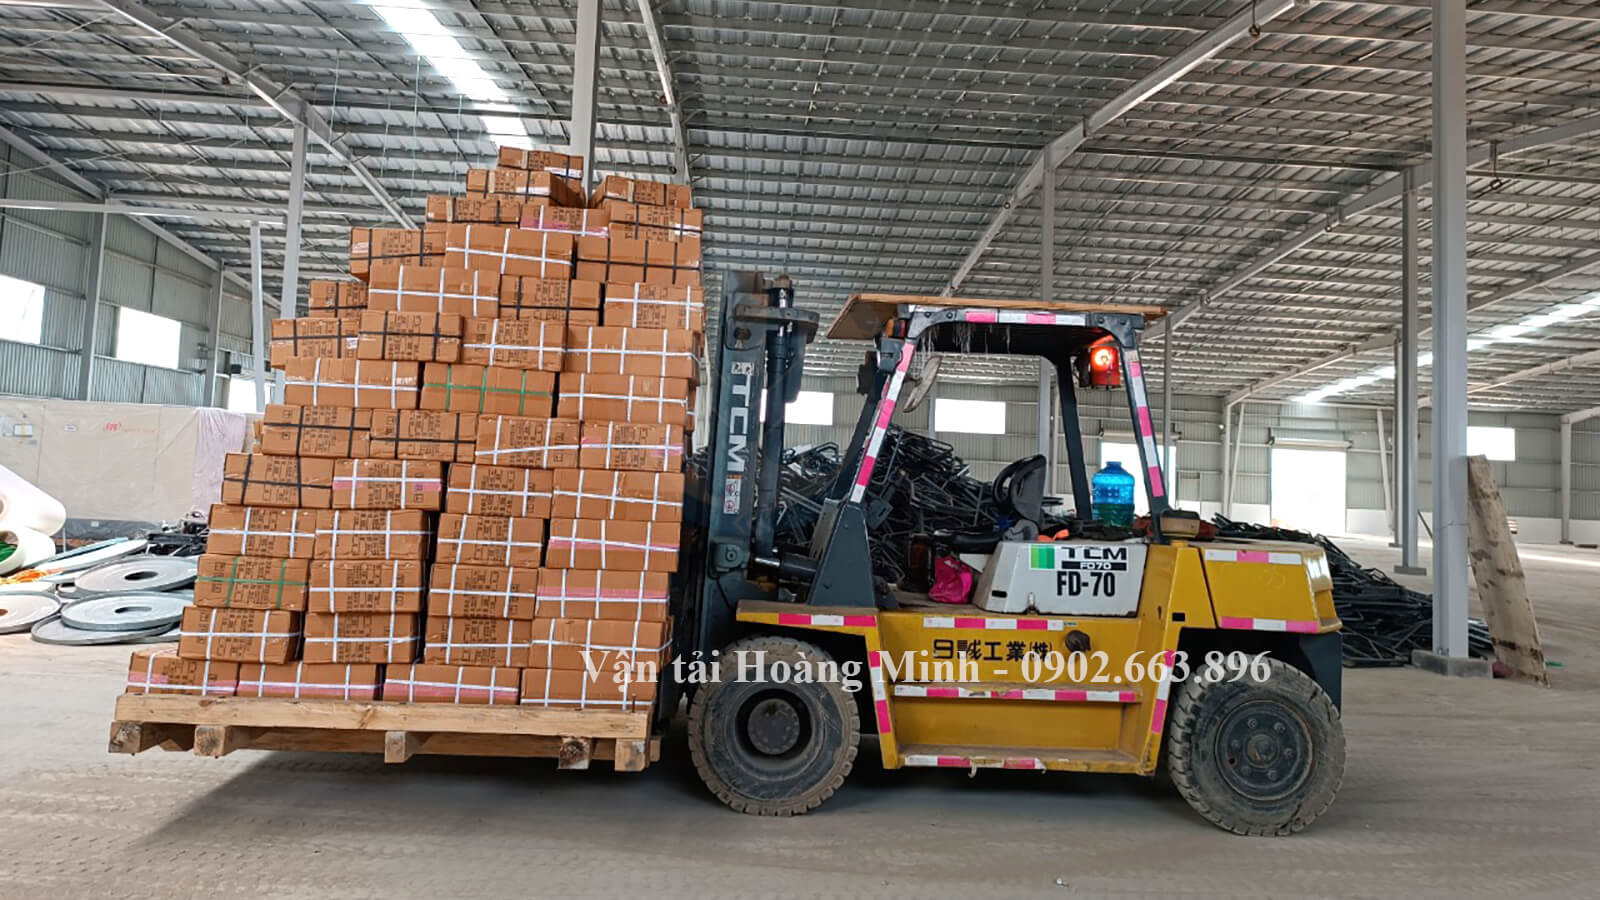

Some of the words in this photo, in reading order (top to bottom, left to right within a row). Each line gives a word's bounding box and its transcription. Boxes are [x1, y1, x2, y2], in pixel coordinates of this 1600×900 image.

[727, 374, 751, 472] TCM
[1061, 546, 1127, 560] TCM
[1056, 571, 1116, 597] FD-70
